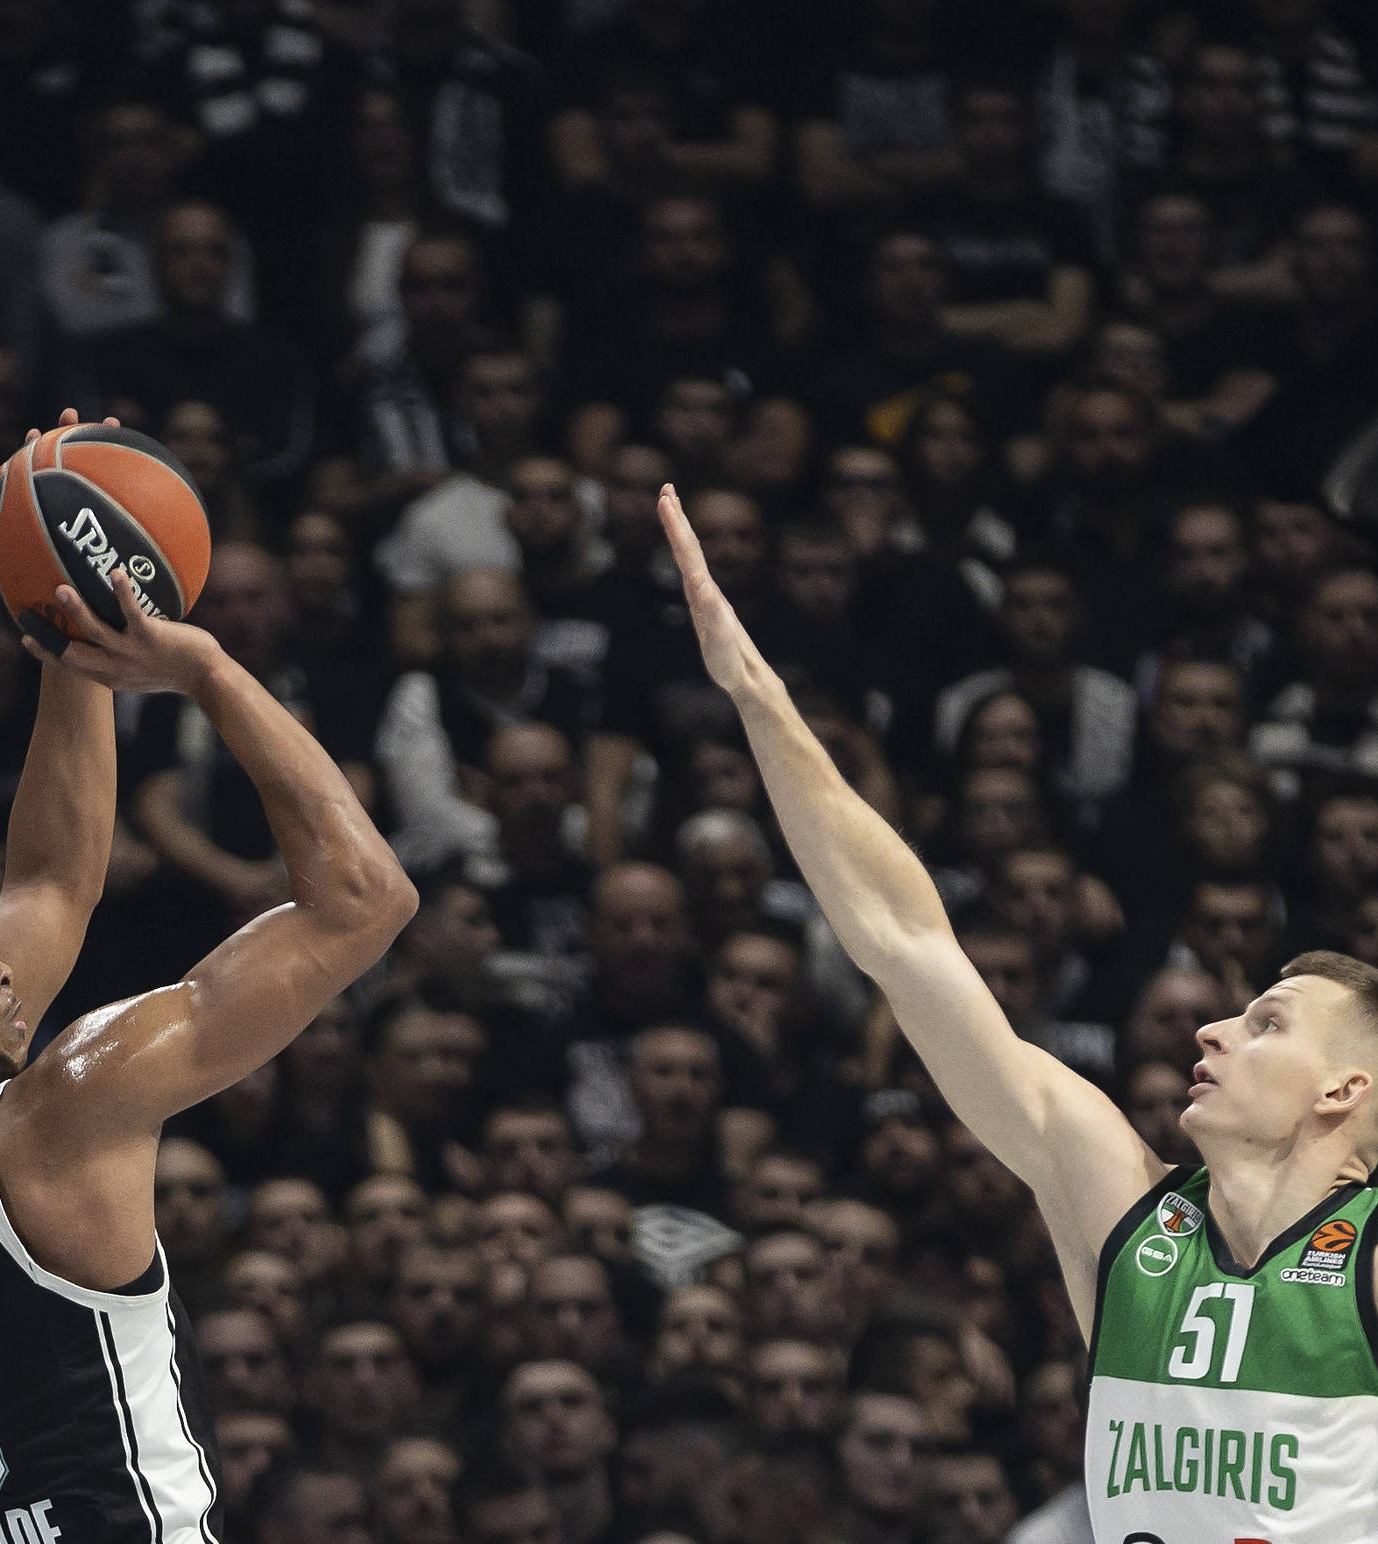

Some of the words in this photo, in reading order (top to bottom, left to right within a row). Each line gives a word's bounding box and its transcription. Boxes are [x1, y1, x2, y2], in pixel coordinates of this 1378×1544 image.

[58, 507, 169, 621] SPADIN
[1282, 1269, 1344, 1285] oneteam
[1169, 1282, 1255, 1382] 51
